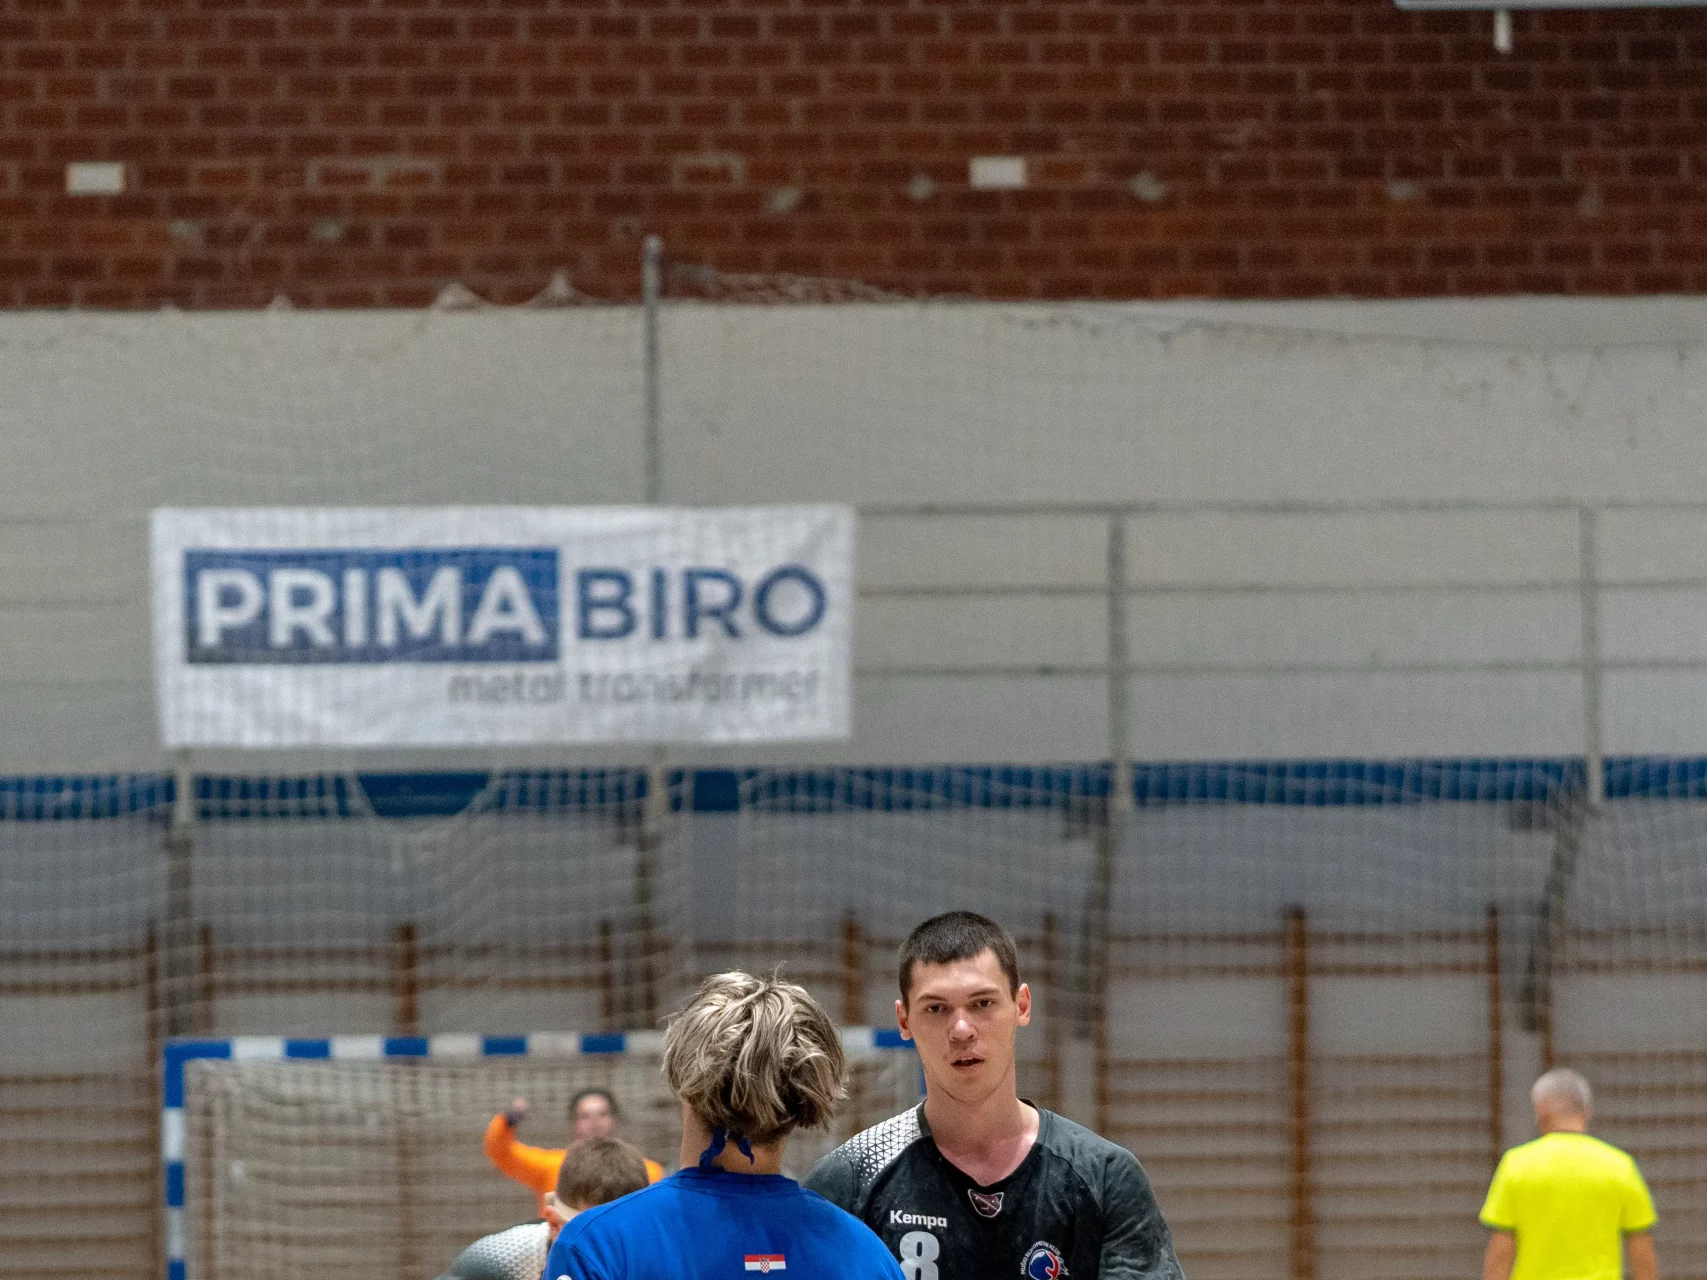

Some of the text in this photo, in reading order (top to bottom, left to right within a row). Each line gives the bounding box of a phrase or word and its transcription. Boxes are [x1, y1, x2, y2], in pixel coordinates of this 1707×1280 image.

[199, 563, 827, 648] PRIMA BIRO
[889, 1209, 948, 1230] Kempa
